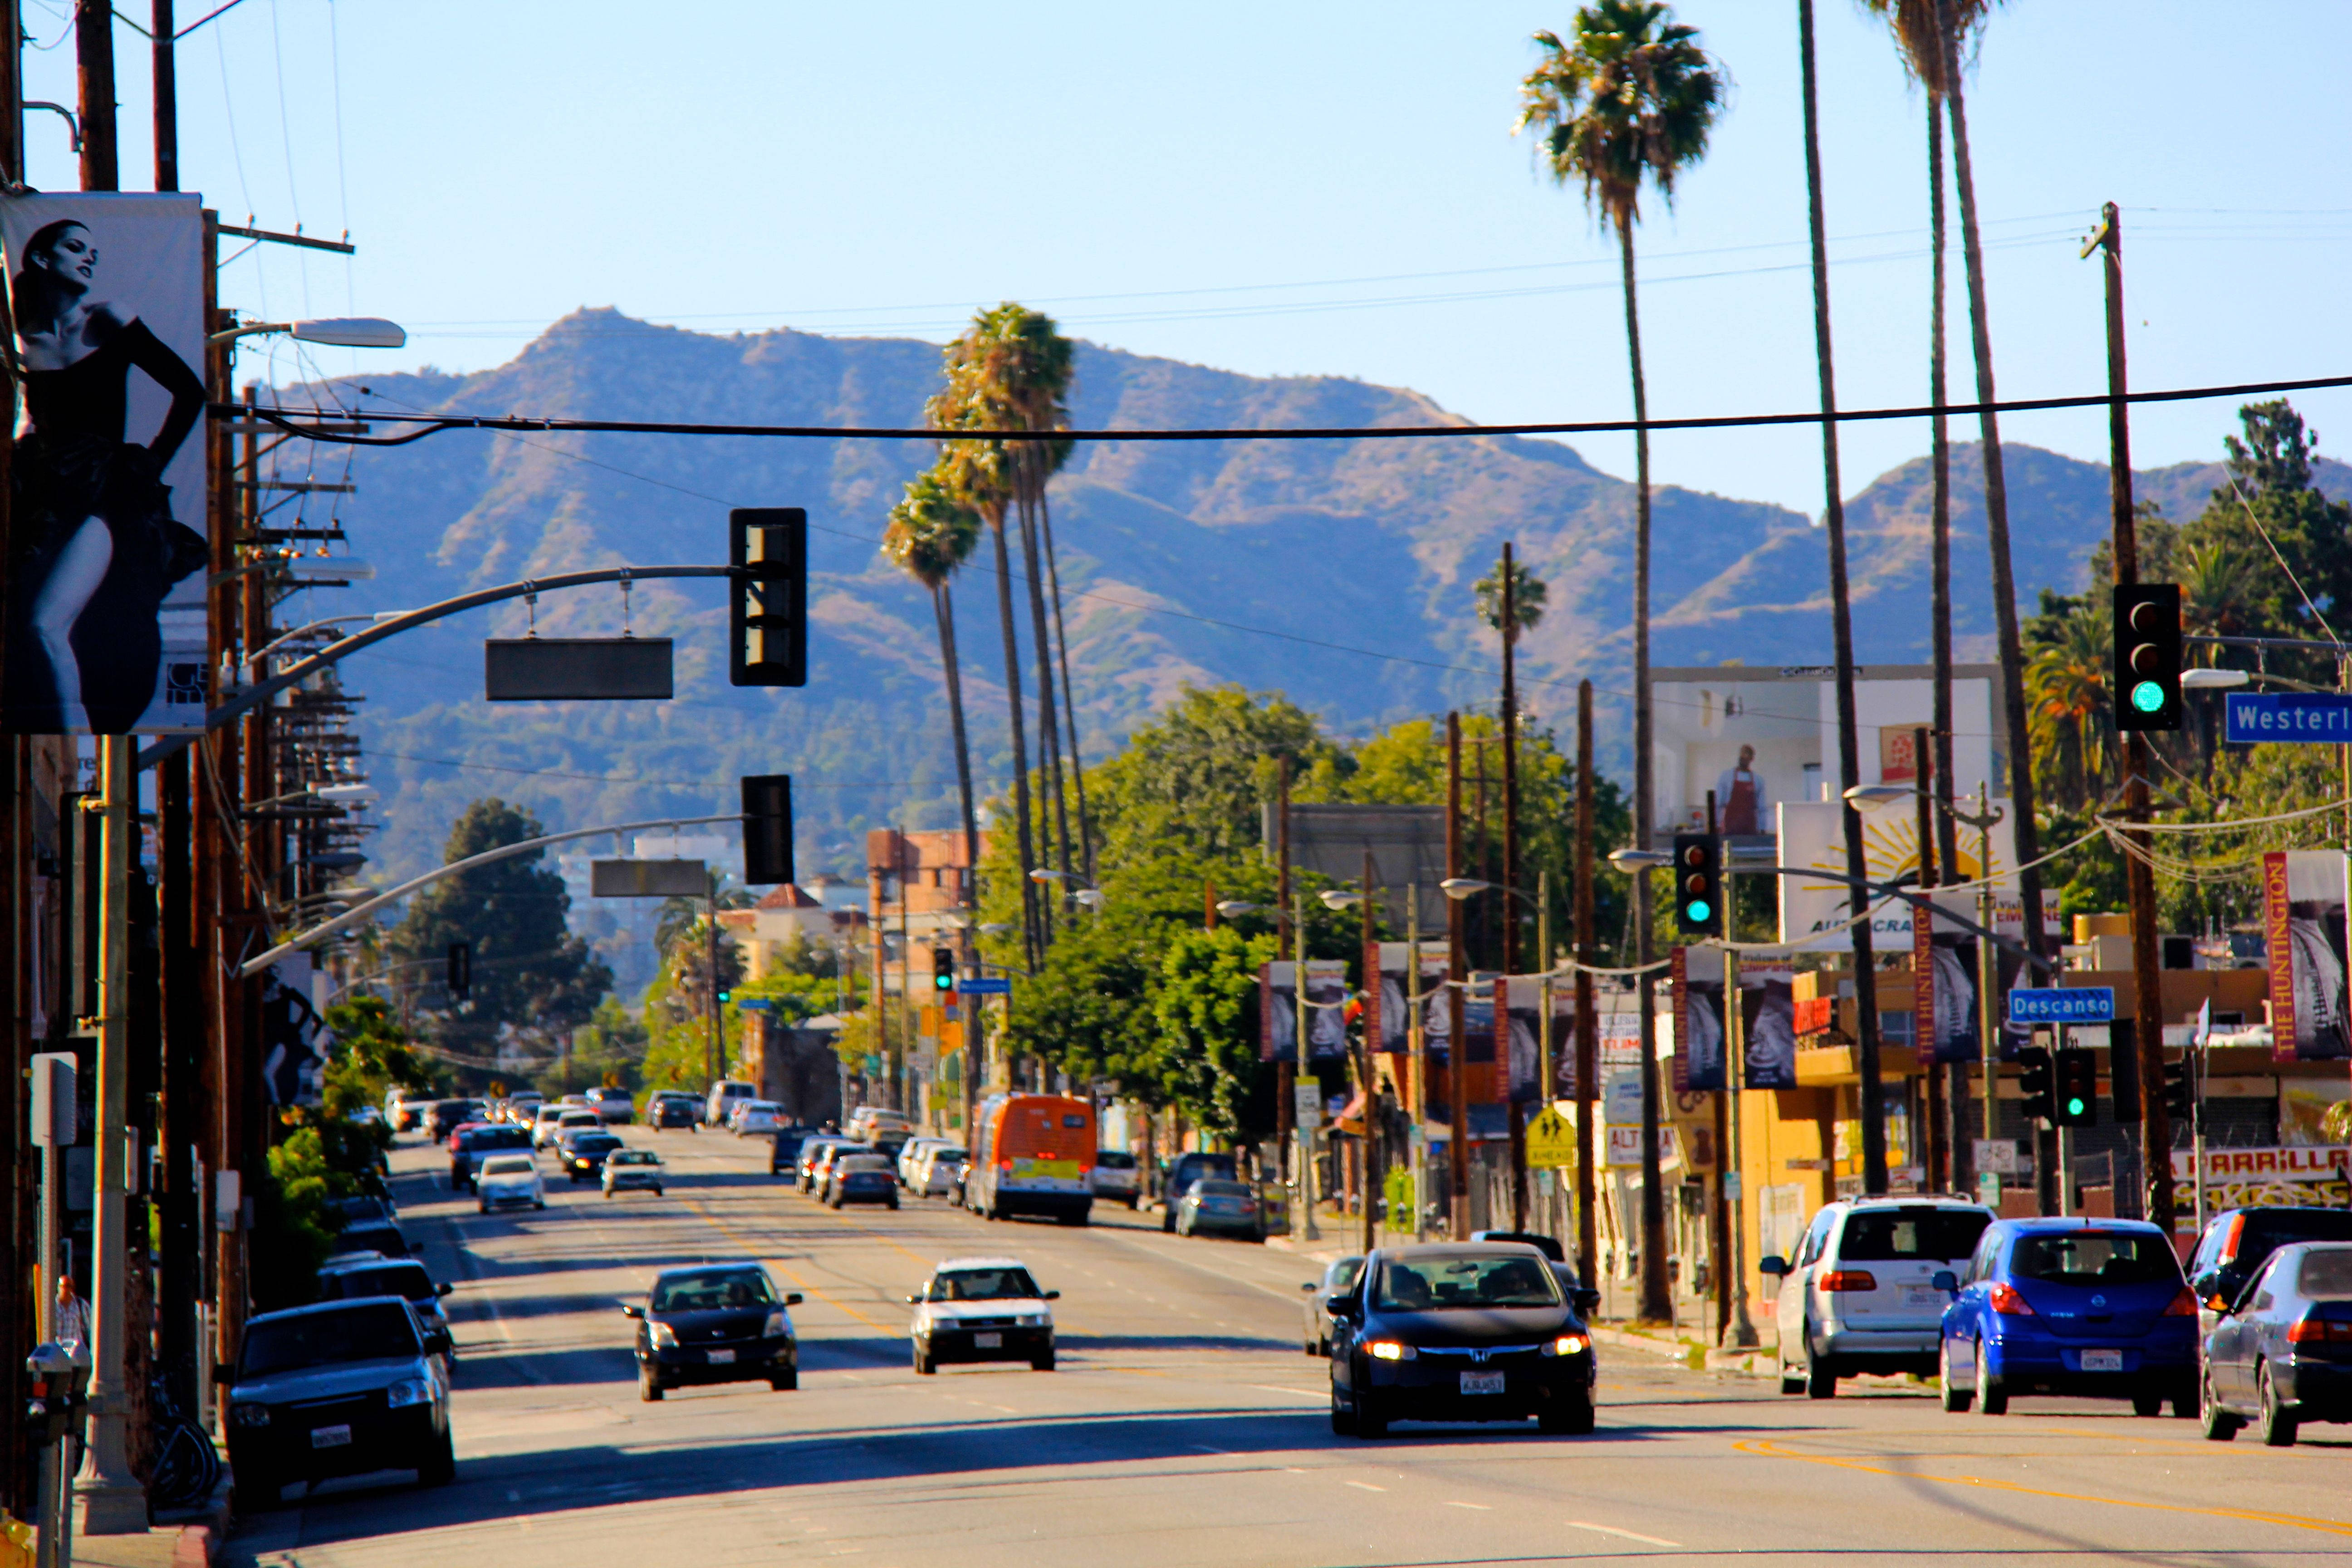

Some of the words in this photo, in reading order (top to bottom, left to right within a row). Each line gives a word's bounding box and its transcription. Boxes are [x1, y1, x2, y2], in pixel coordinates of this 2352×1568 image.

[2269, 862, 2292, 1007] HUNTINGTON
[2014, 998, 2109, 1014] Descanso
[2276, 1013, 2295, 1054] THE
